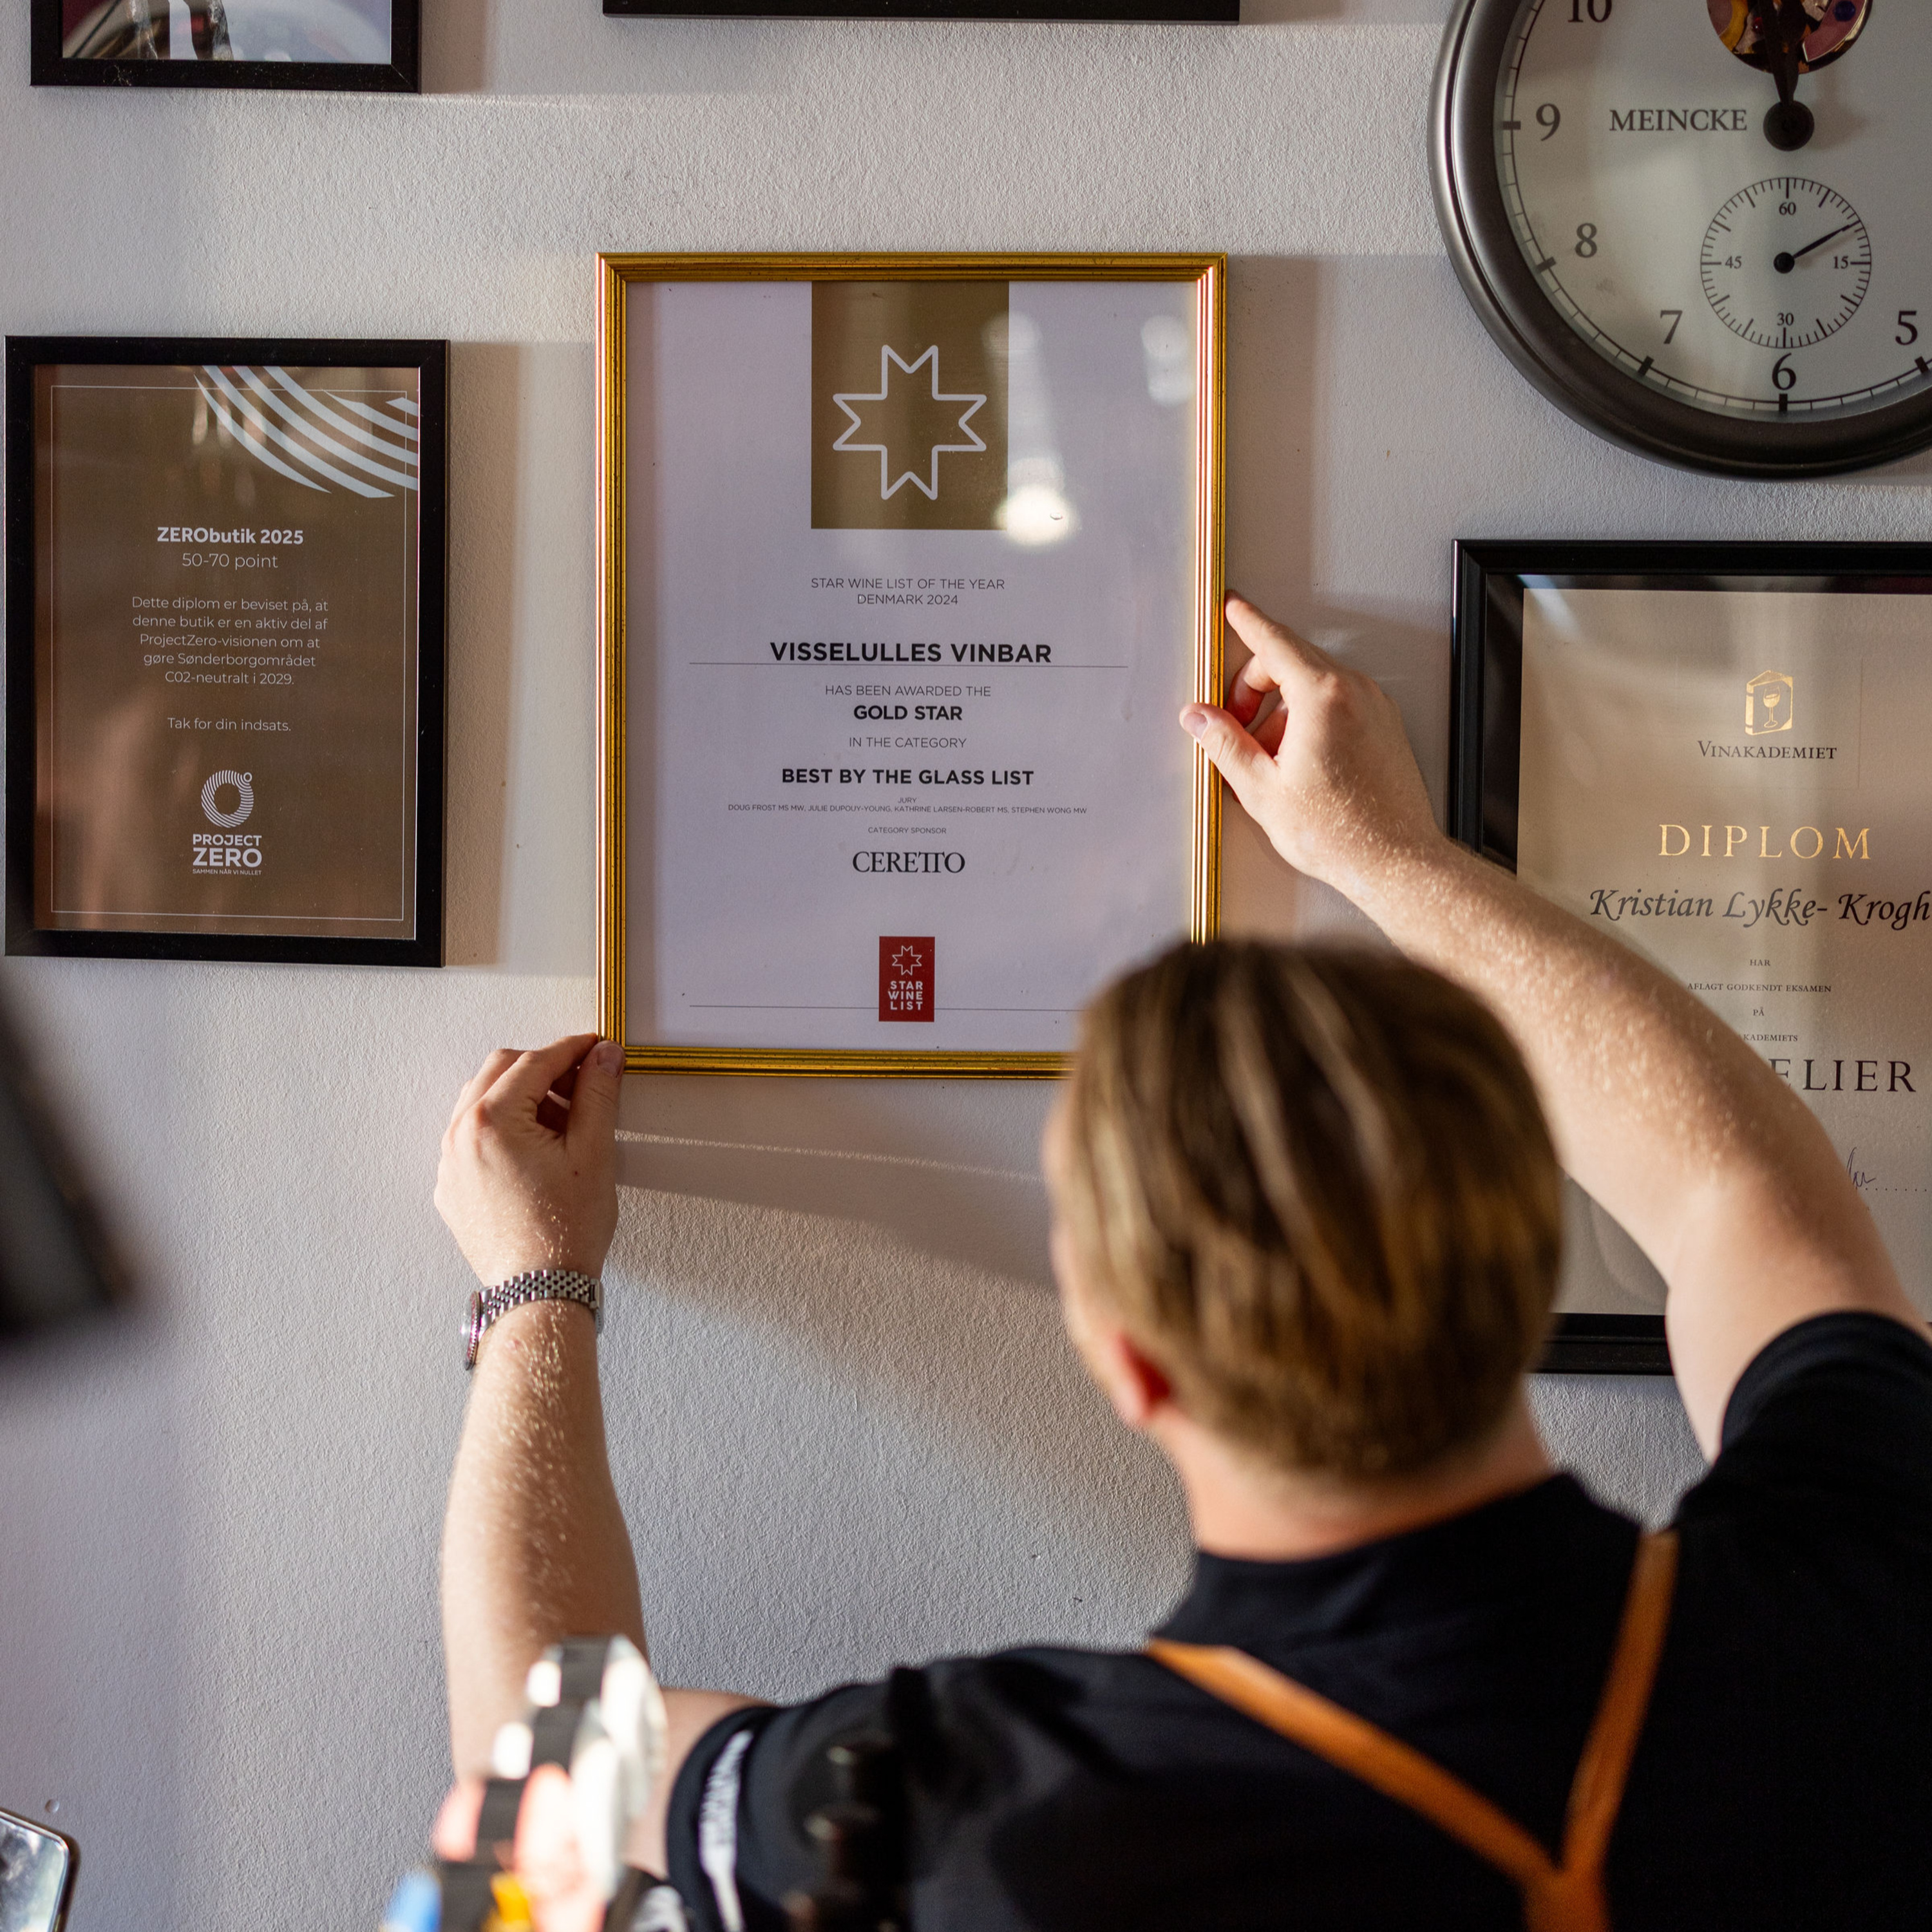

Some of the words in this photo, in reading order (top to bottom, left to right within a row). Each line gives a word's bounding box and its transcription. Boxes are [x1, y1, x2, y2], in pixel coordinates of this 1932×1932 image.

[1568, 0, 1612, 23] 10
[1536, 104, 1560, 141] 9
[1610, 109, 1747, 131] MEINCKE
[1779, 202, 1796, 215] 60
[1575, 223, 1597, 258] 8
[1725, 256, 1741, 269] 45
[1834, 256, 1848, 269] 15
[1777, 313, 1794, 326] 30
[1660, 310, 1682, 345] 7
[1895, 310, 1918, 345] 5
[1772, 353, 1796, 390] 6
[157, 527, 256, 543] ZERObutik
[261, 529, 303, 544] 2025
[182, 553, 229, 567] 50-70
[235, 554, 278, 570] point
[811, 578, 844, 588] STAR
[848, 578, 882, 589] WINE
[887, 578, 913, 589] LIST
[918, 578, 935, 589] OF
[940, 579, 965, 589] THE
[969, 579, 1005, 589] YEAR
[133, 596, 169, 608] Dette
[173, 597, 220, 611] diplom
[224, 601, 237, 609] er
[242, 598, 288, 610] beviset
[293, 599, 311, 612] på,
[316, 601, 328, 611] at
[858, 594, 923, 604] DENMARK
[927, 594, 958, 605] 2024
[133, 615, 176, 627] denne
[180, 616, 214, 627] butik
[235, 620, 251, 628] en
[256, 617, 287, 629] aktiv
[291, 618, 310, 629] del
[316, 618, 328, 629] af
[140, 634, 276, 648] ProjectZero-visionen
[281, 639, 303, 647] om
[307, 638, 319, 648] at
[144, 655, 174, 666] gøre
[178, 653, 316, 668] Sønderborgområdet
[770, 643, 941, 661] VISSELULLES
[951, 644, 1051, 663] VINBAR
[254, 673, 256, 683] i
[260, 673, 294, 685] 2029.
[826, 685, 852, 696] HAS
[857, 685, 891, 696] BEEN
[895, 686, 961, 696] AWARDED
[966, 686, 990, 696] THE
[854, 705, 907, 719] GOLD
[915, 706, 962, 720] STAR
[167, 717, 190, 728] Tak
[194, 717, 212, 729] for
[216, 719, 236, 730] din
[242, 719, 290, 731] indsats.
[849, 737, 861, 746] IN
[866, 737, 891, 747] THE
[895, 737, 967, 748] CATEGORY
[782, 769, 832, 783] BEST
[840, 770, 866, 783] BY
[873, 770, 911, 784] THE
[919, 770, 984, 784] GLASS
[992, 771, 1034, 785] LIST
[193, 834, 261, 846] PROJECT
[1659, 824, 1869, 859] DIPLOM
[193, 848, 261, 867] ZERO
[853, 851, 965, 873] CERETTO
[1590, 889, 1713, 920] Kristian
[1723, 888, 1828, 927] Lykke-
[1839, 891, 1931, 931] Krogh
[891, 981, 923, 990] STAR
[888, 991, 922, 1000] WINE
[891, 1001, 922, 1010] LIST
[1754, 1007, 1764, 1016] PÅ
